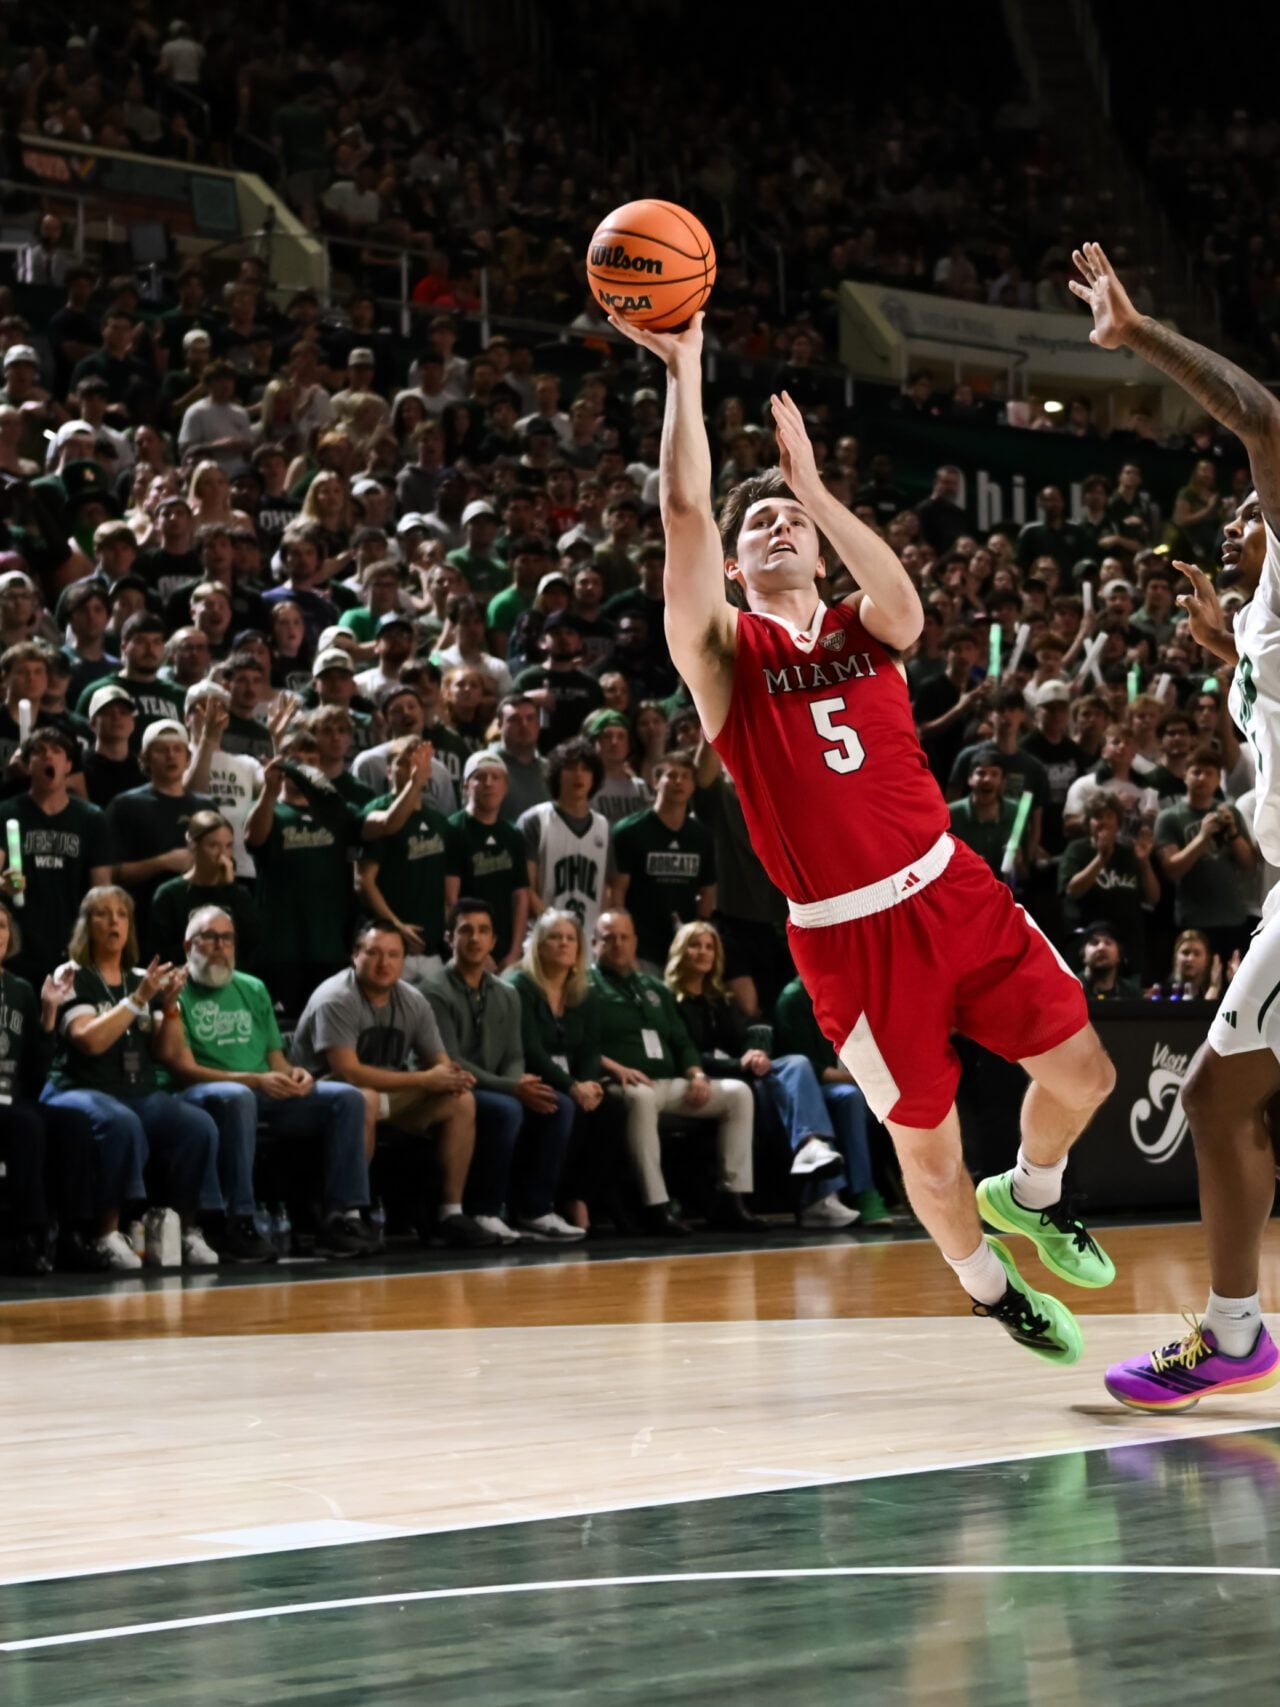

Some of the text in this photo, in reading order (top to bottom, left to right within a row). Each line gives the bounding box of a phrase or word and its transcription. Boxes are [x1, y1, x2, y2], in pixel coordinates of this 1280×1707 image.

[590, 245, 663, 275] Wilson
[598, 288, 652, 311] NCAA
[762, 652, 879, 695] MIAMI
[808, 696, 867, 775] 5
[24, 830, 80, 858] JESUS
[34, 855, 65, 870] WON
[647, 854, 698, 873] BOBCATS
